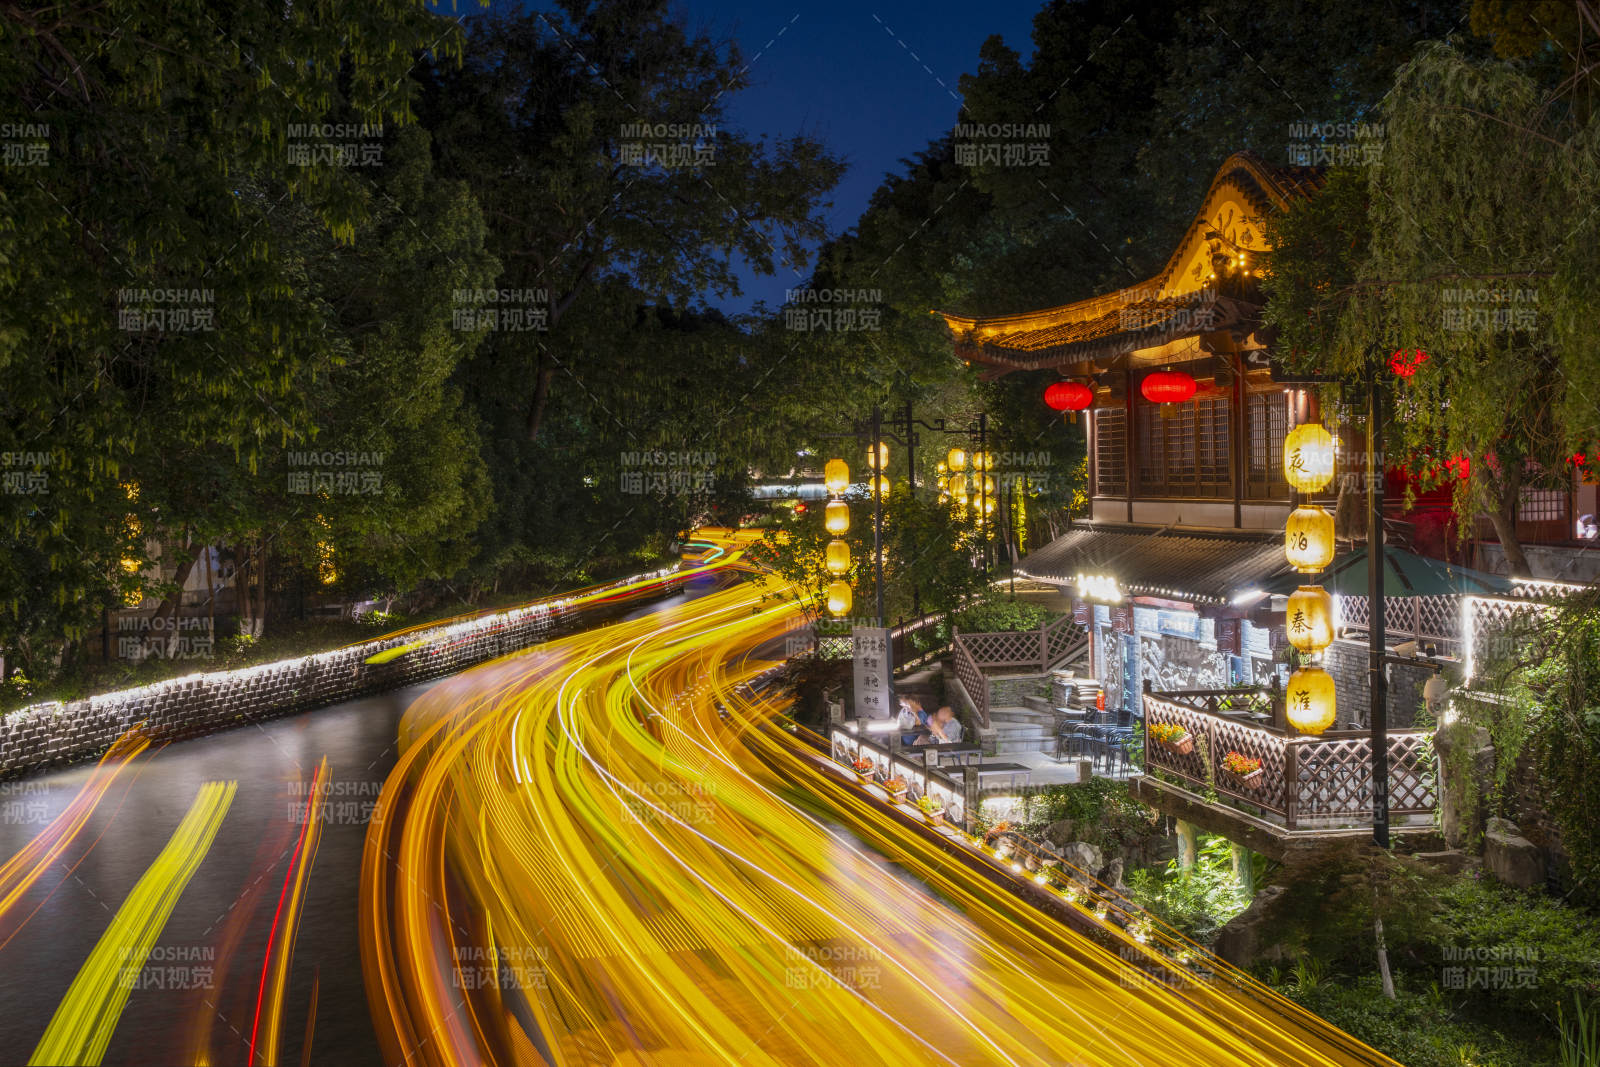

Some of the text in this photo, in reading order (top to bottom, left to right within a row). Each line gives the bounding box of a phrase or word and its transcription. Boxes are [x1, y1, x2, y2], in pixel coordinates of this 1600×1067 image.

[1289, 448, 1311, 474] 夜
[1290, 531, 1308, 552] 泊
[1290, 608, 1312, 634] 秦
